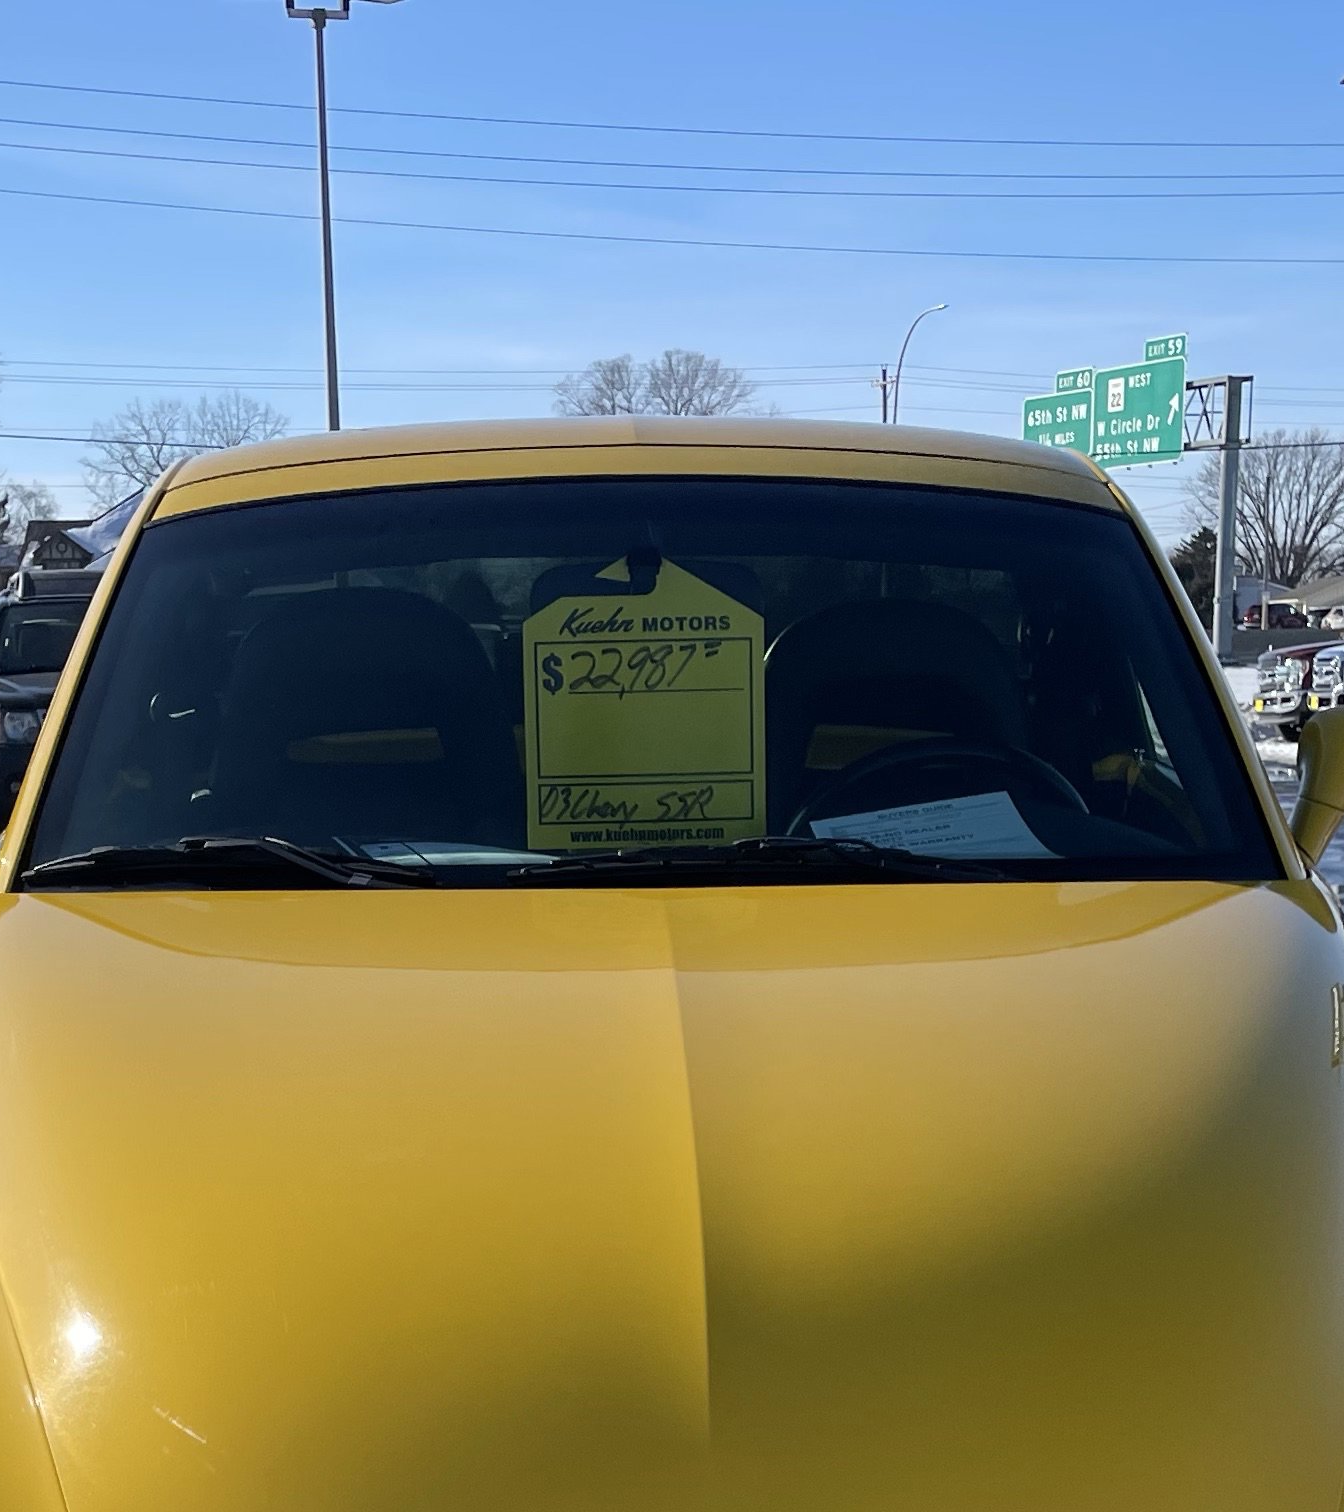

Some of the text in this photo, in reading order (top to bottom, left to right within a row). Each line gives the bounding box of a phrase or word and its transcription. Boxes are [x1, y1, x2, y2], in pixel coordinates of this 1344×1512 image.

[1148, 338, 1183, 357] EXIT 59
[1058, 371, 1091, 389] EXIT 60
[1128, 372, 1152, 388] WEST
[1110, 392, 1122, 408] 22
[1027, 403, 1088, 427] 65th St NW
[1097, 413, 1161, 437] W Circle Dr
[1095, 436, 1160, 461] 55th St NW
[559, 606, 731, 638] Kuehn MOTORS
[570, 826, 725, 843] www.kuehnmotors.com
